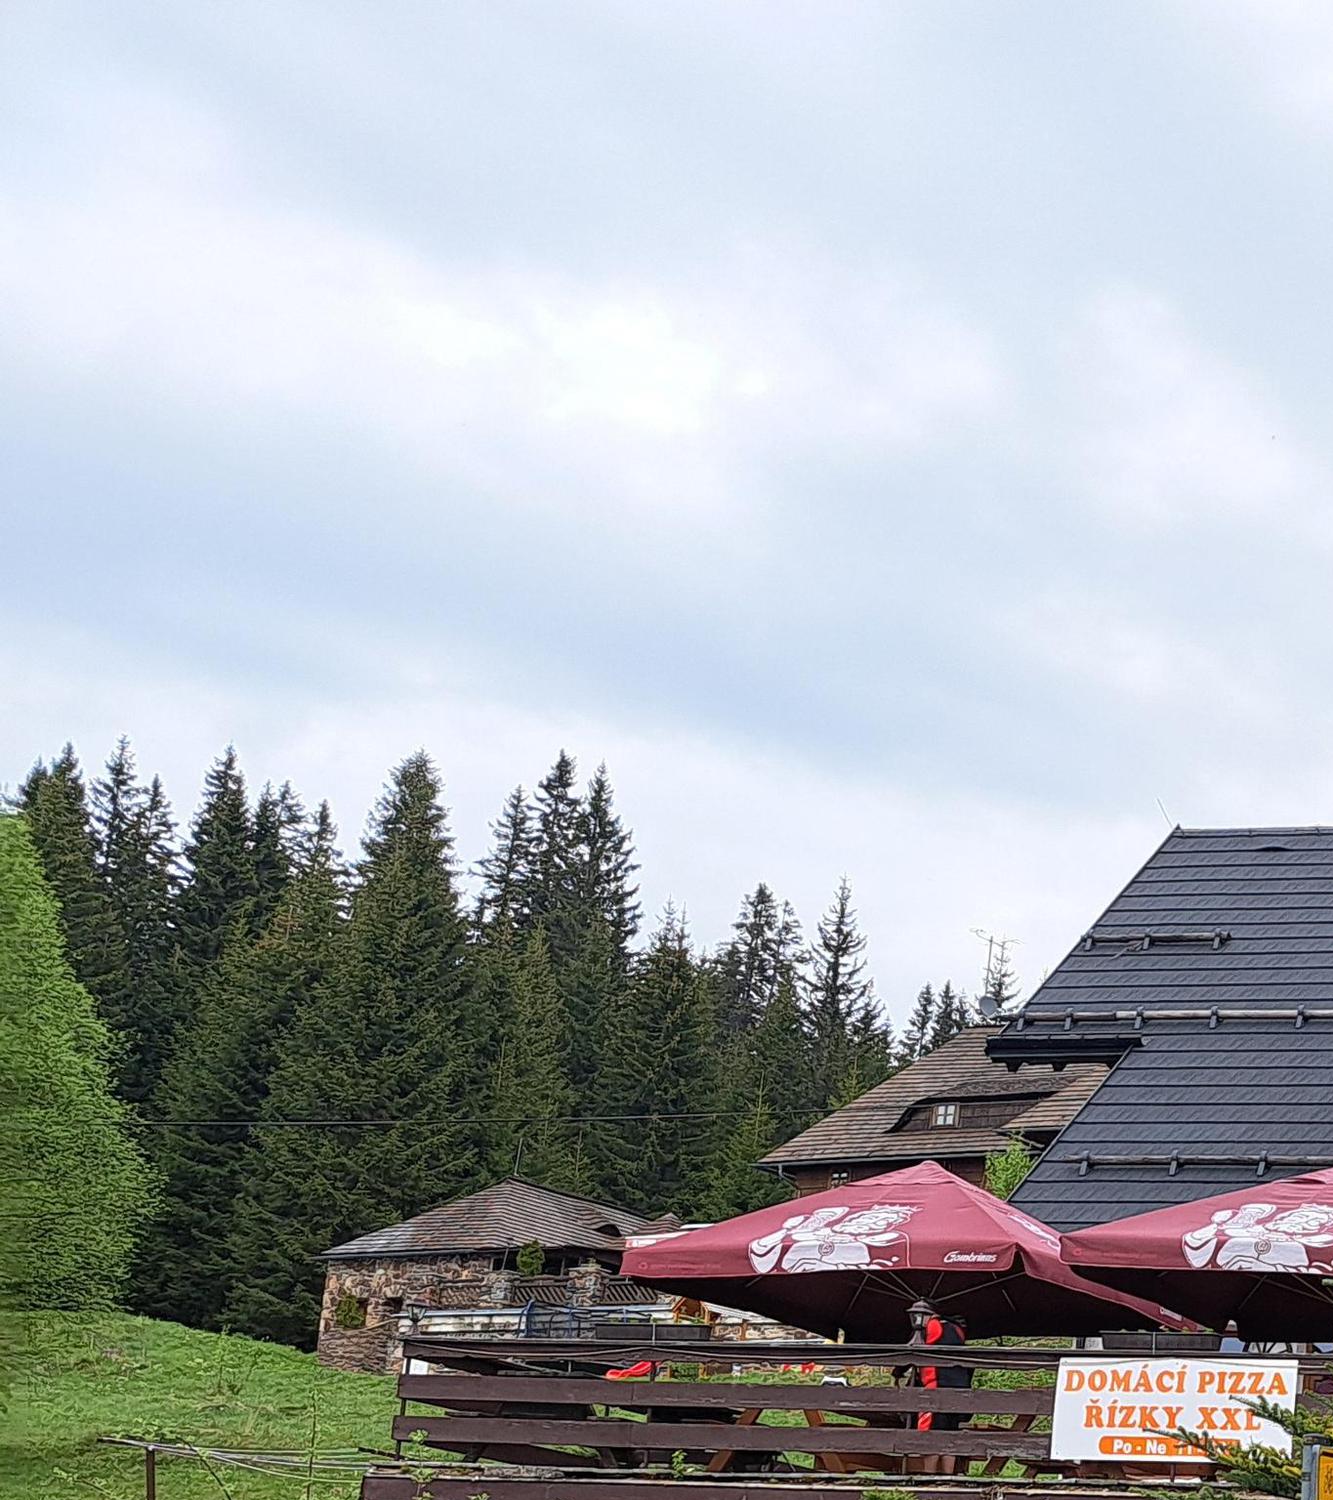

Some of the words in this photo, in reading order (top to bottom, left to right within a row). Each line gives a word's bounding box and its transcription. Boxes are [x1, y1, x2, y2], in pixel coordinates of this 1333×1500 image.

[944, 1250, 997, 1263] Gambrinus
[1064, 1364, 1187, 1393] DOMÁCÍ
[1197, 1371, 1289, 1395] PIZZA
[1084, 1398, 1184, 1429] ŘÍZKY
[1196, 1407, 1261, 1431] XXL
[1113, 1439, 1131, 1453] Po
[1146, 1439, 1167, 1454] Ne
